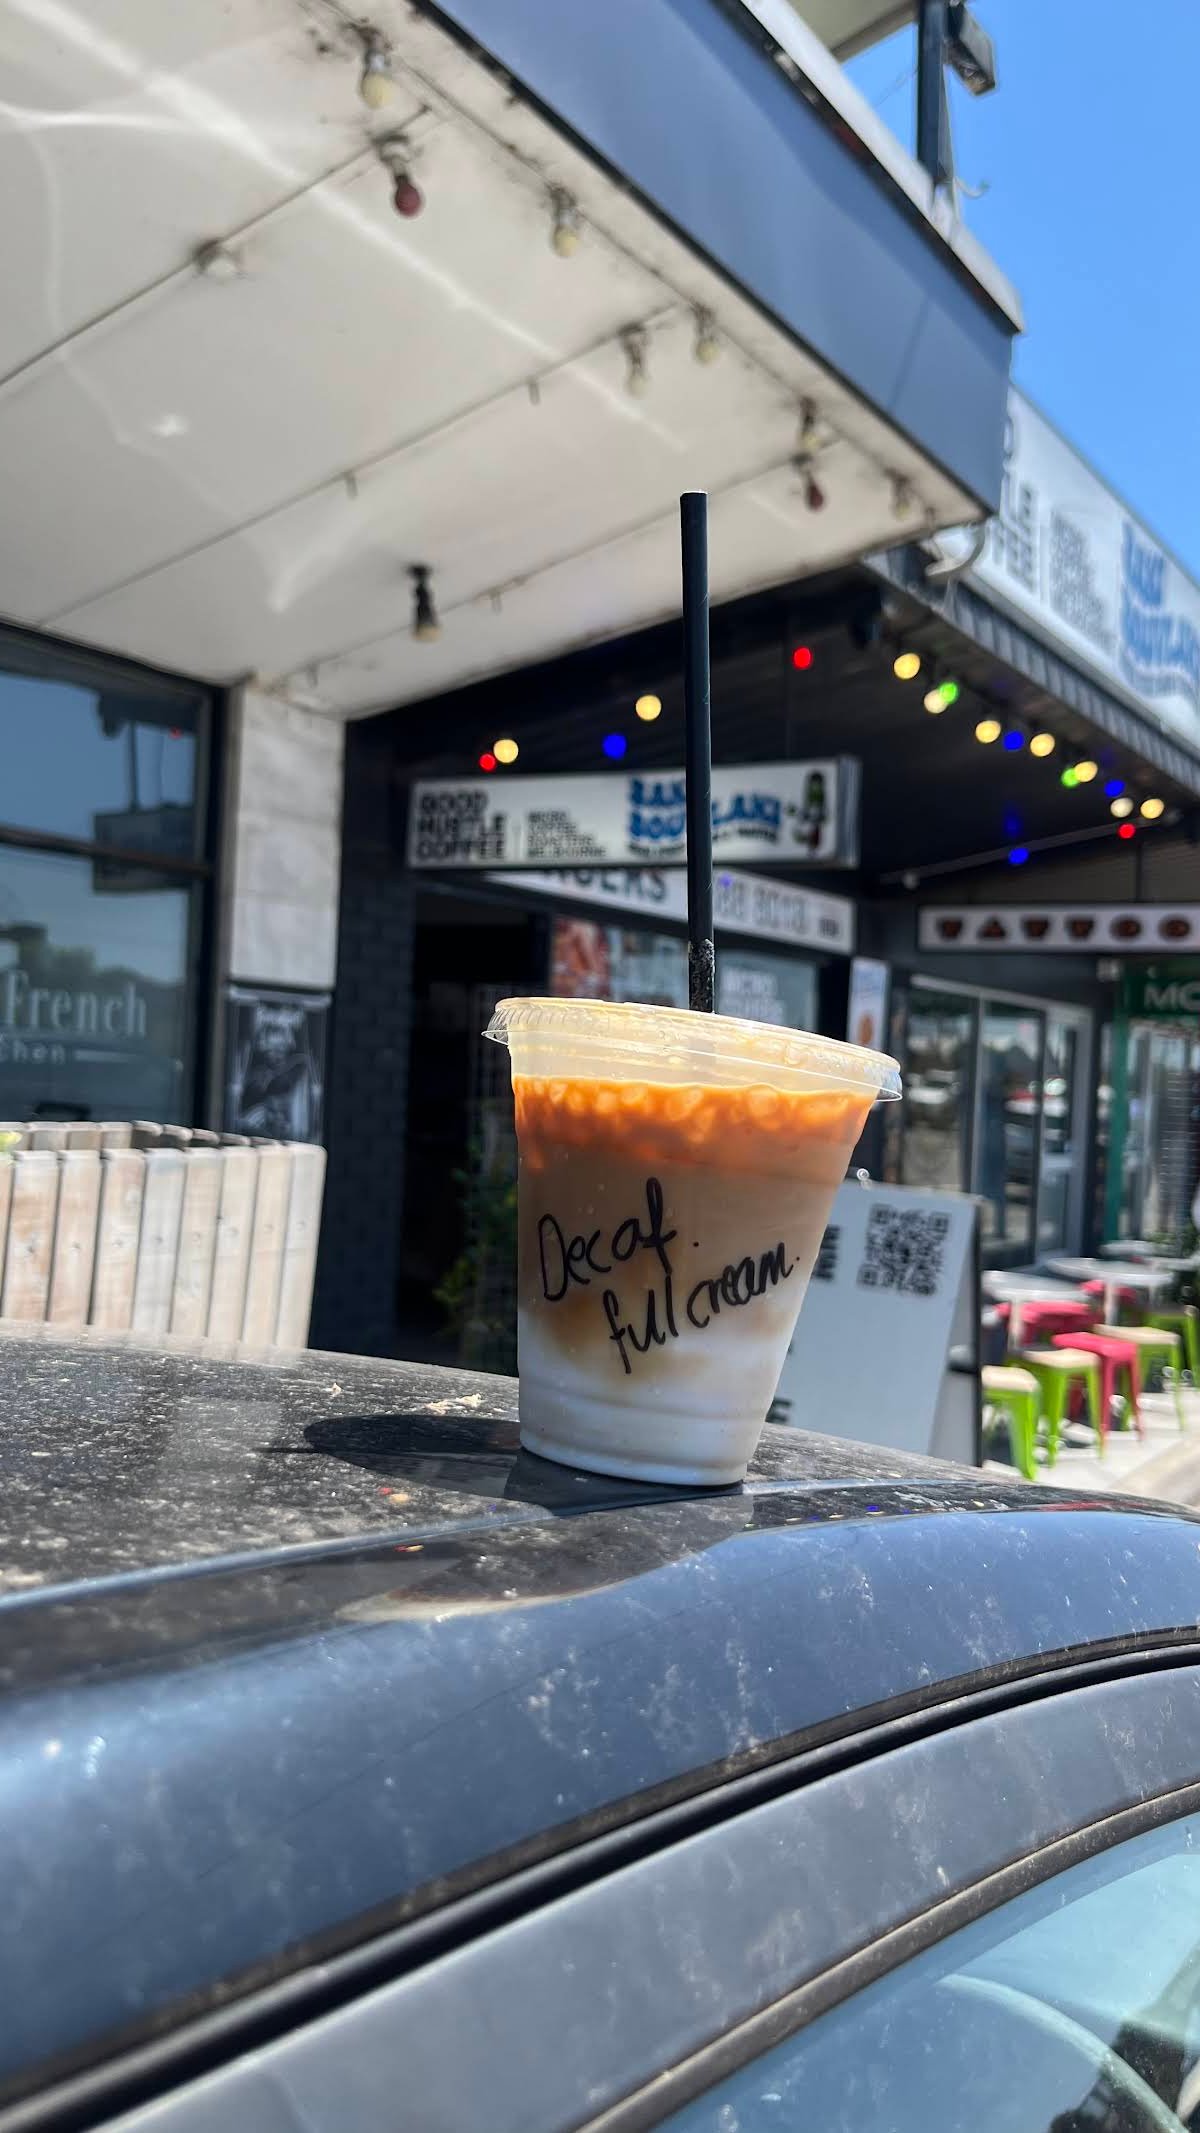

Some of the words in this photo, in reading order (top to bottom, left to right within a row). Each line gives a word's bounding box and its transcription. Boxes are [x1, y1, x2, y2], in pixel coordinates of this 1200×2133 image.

[419, 790, 489, 816] GOOD
[417, 814, 505, 840] HUSTLE
[417, 839, 505, 860] COFFEE
[5, 969, 147, 1038] French
